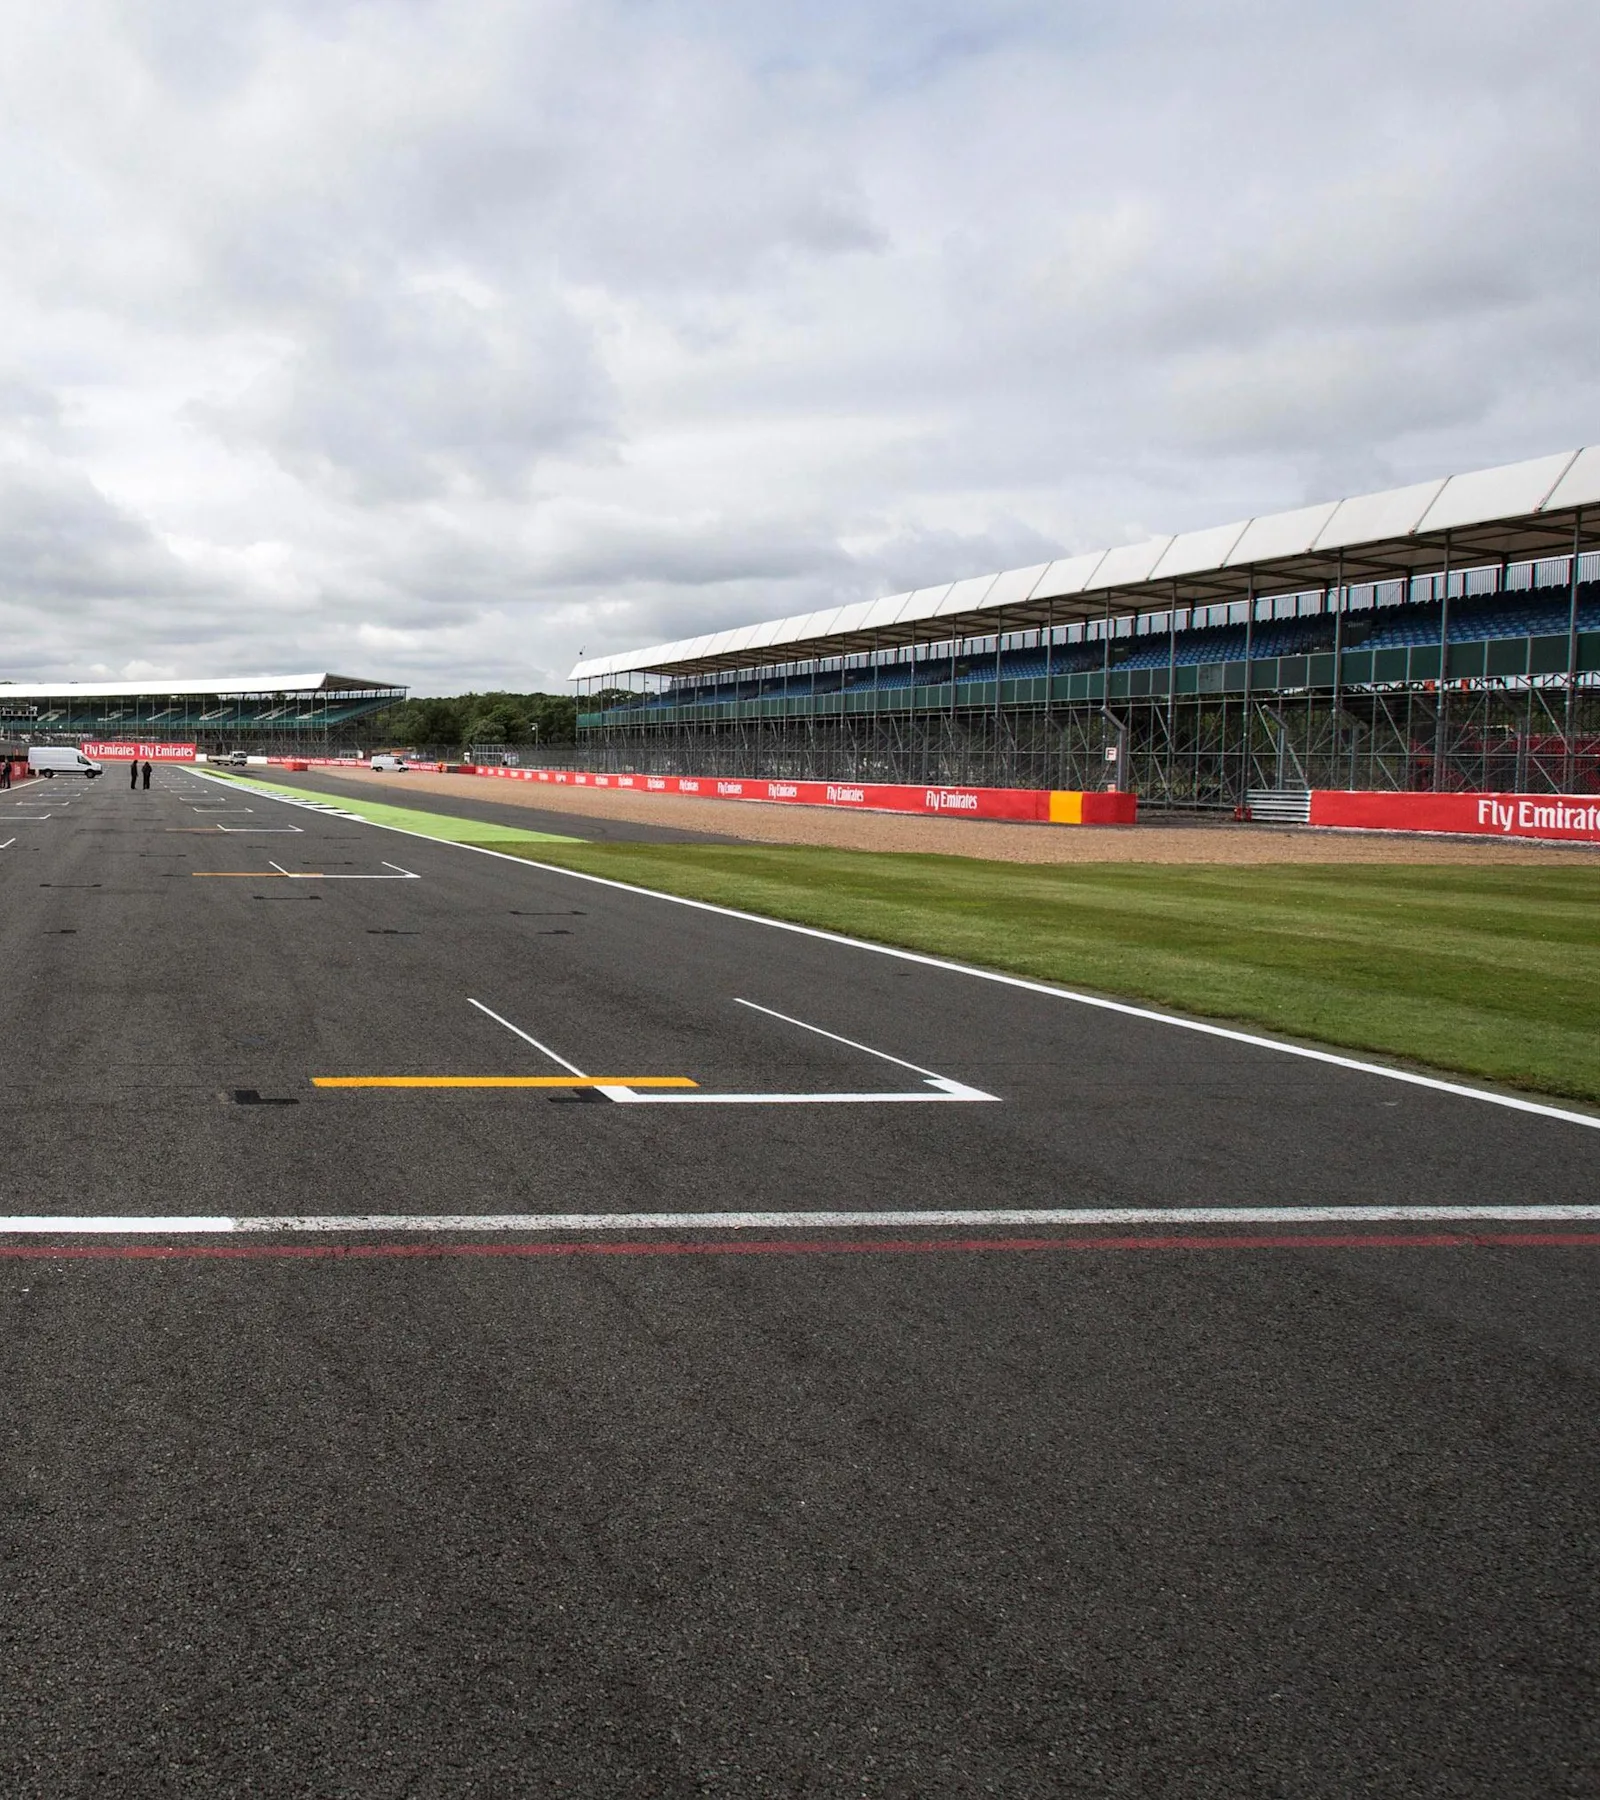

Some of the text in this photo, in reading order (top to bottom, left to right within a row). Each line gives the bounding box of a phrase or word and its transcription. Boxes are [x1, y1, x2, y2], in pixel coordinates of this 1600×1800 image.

[84, 743, 135, 757] Fly Emirates
[139, 745, 194, 758] Fly Emirates
[1107, 749, 1115, 760] F
[827, 786, 864, 804] Fly Emirates
[926, 789, 978, 811] Fly Emirates
[1478, 799, 1514, 832] Fly
